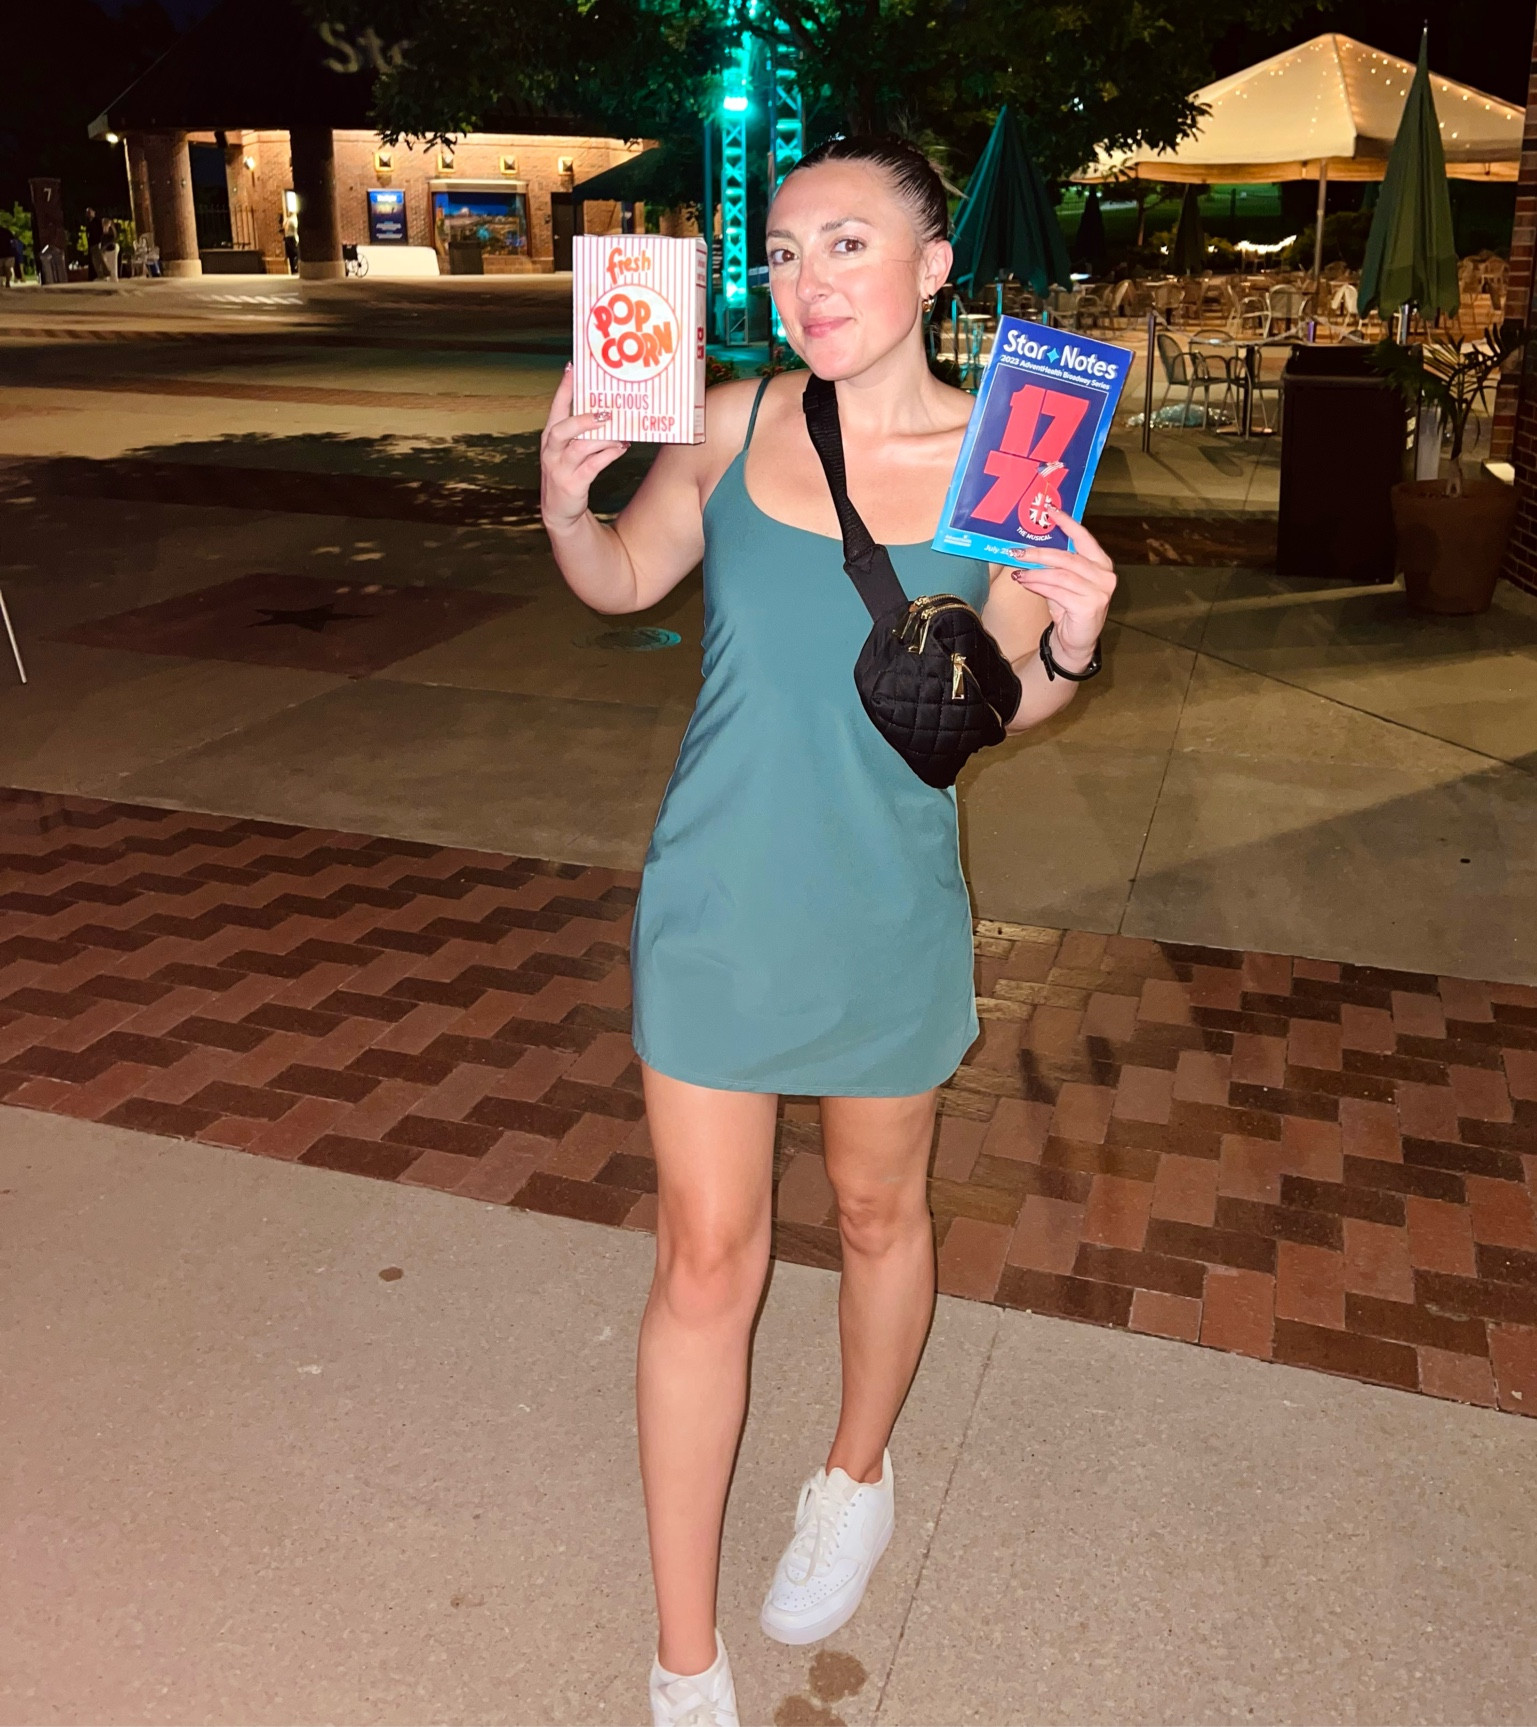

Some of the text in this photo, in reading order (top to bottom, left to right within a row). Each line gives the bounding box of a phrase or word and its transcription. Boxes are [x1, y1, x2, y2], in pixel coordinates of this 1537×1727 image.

[43, 187, 52, 203] 7
[606, 247, 652, 285] fresh
[593, 293, 652, 339] POP
[601, 321, 673, 369] CORN
[1003, 329, 1119, 380] Star Notes
[1000, 354, 1111, 391] 2023 AdventHealth Broadway Series
[589, 392, 649, 410] DELICIOUS
[642, 415, 675, 432] CRISP
[1000, 384, 1090, 463] 17
[970, 450, 1069, 535] 76
[984, 544, 1000, 555] July
[1016, 526, 1053, 542] THE MUSICAL
